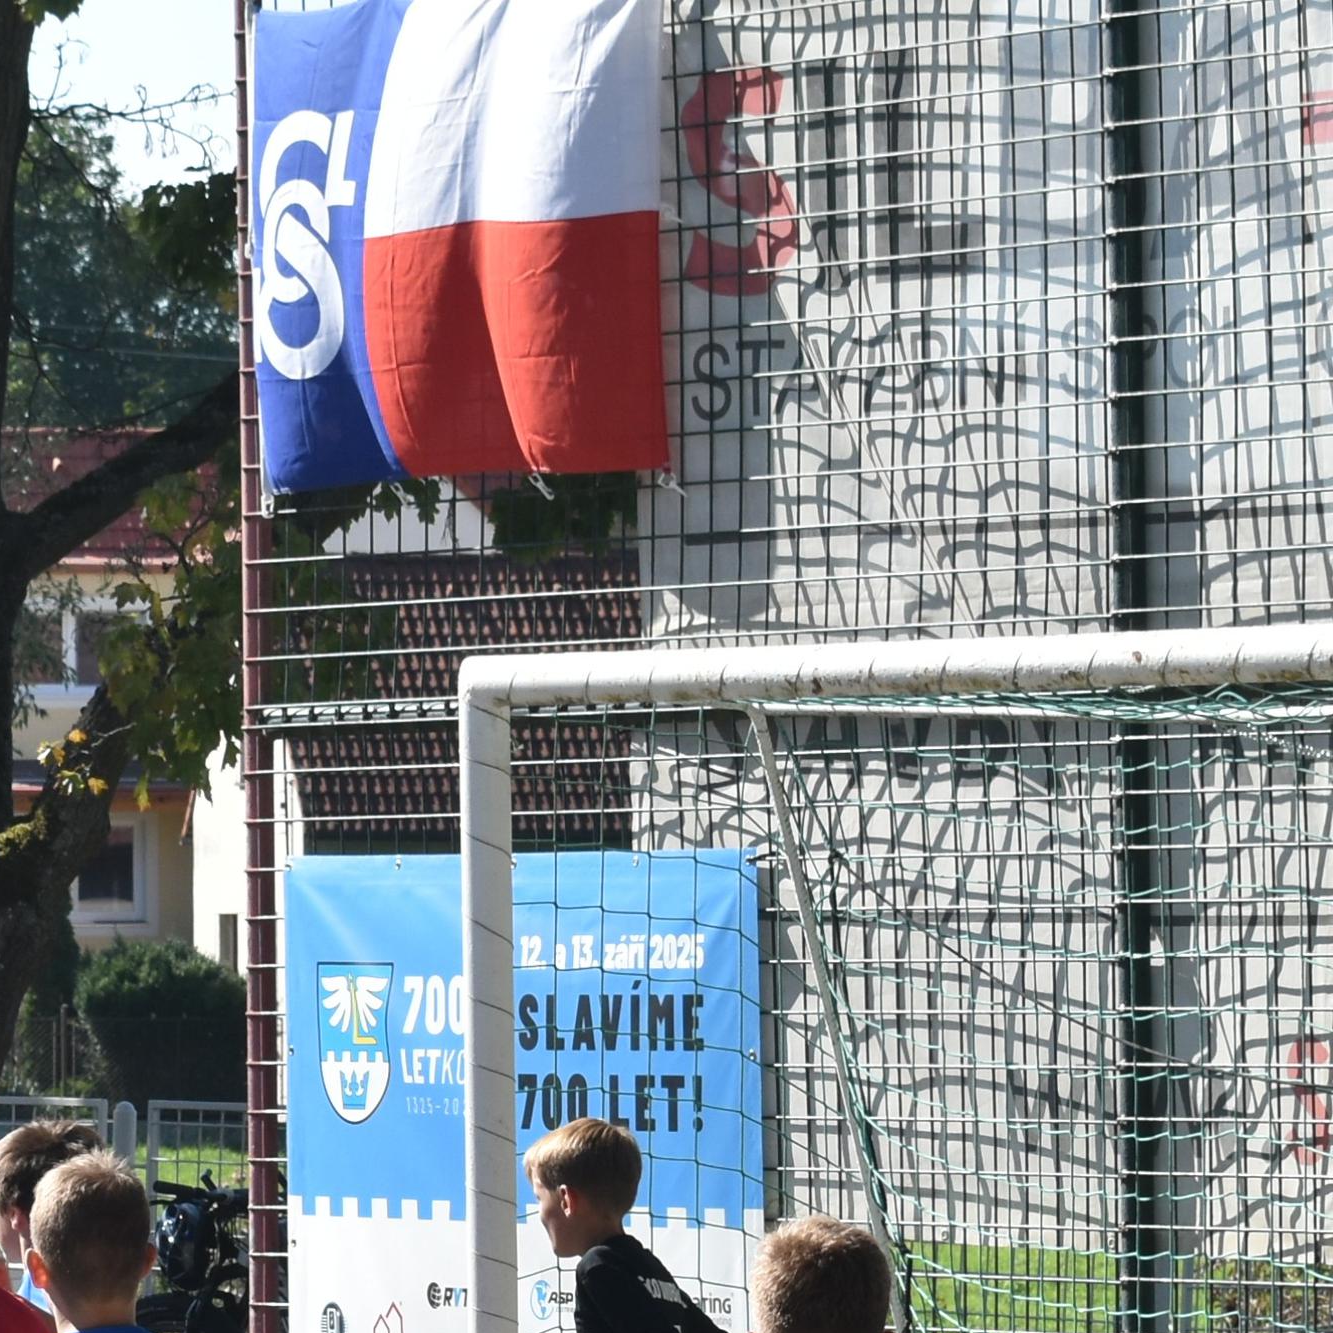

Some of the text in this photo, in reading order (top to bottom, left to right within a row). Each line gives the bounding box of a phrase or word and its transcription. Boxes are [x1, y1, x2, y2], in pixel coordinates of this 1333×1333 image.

[690, 302, 1031, 423] STAVEBNÍ
[519, 933, 705, 970] 12. a 13. září 2025
[518, 979, 705, 1052] SLAVÍME
[517, 1072, 704, 1133] 700 LET!
